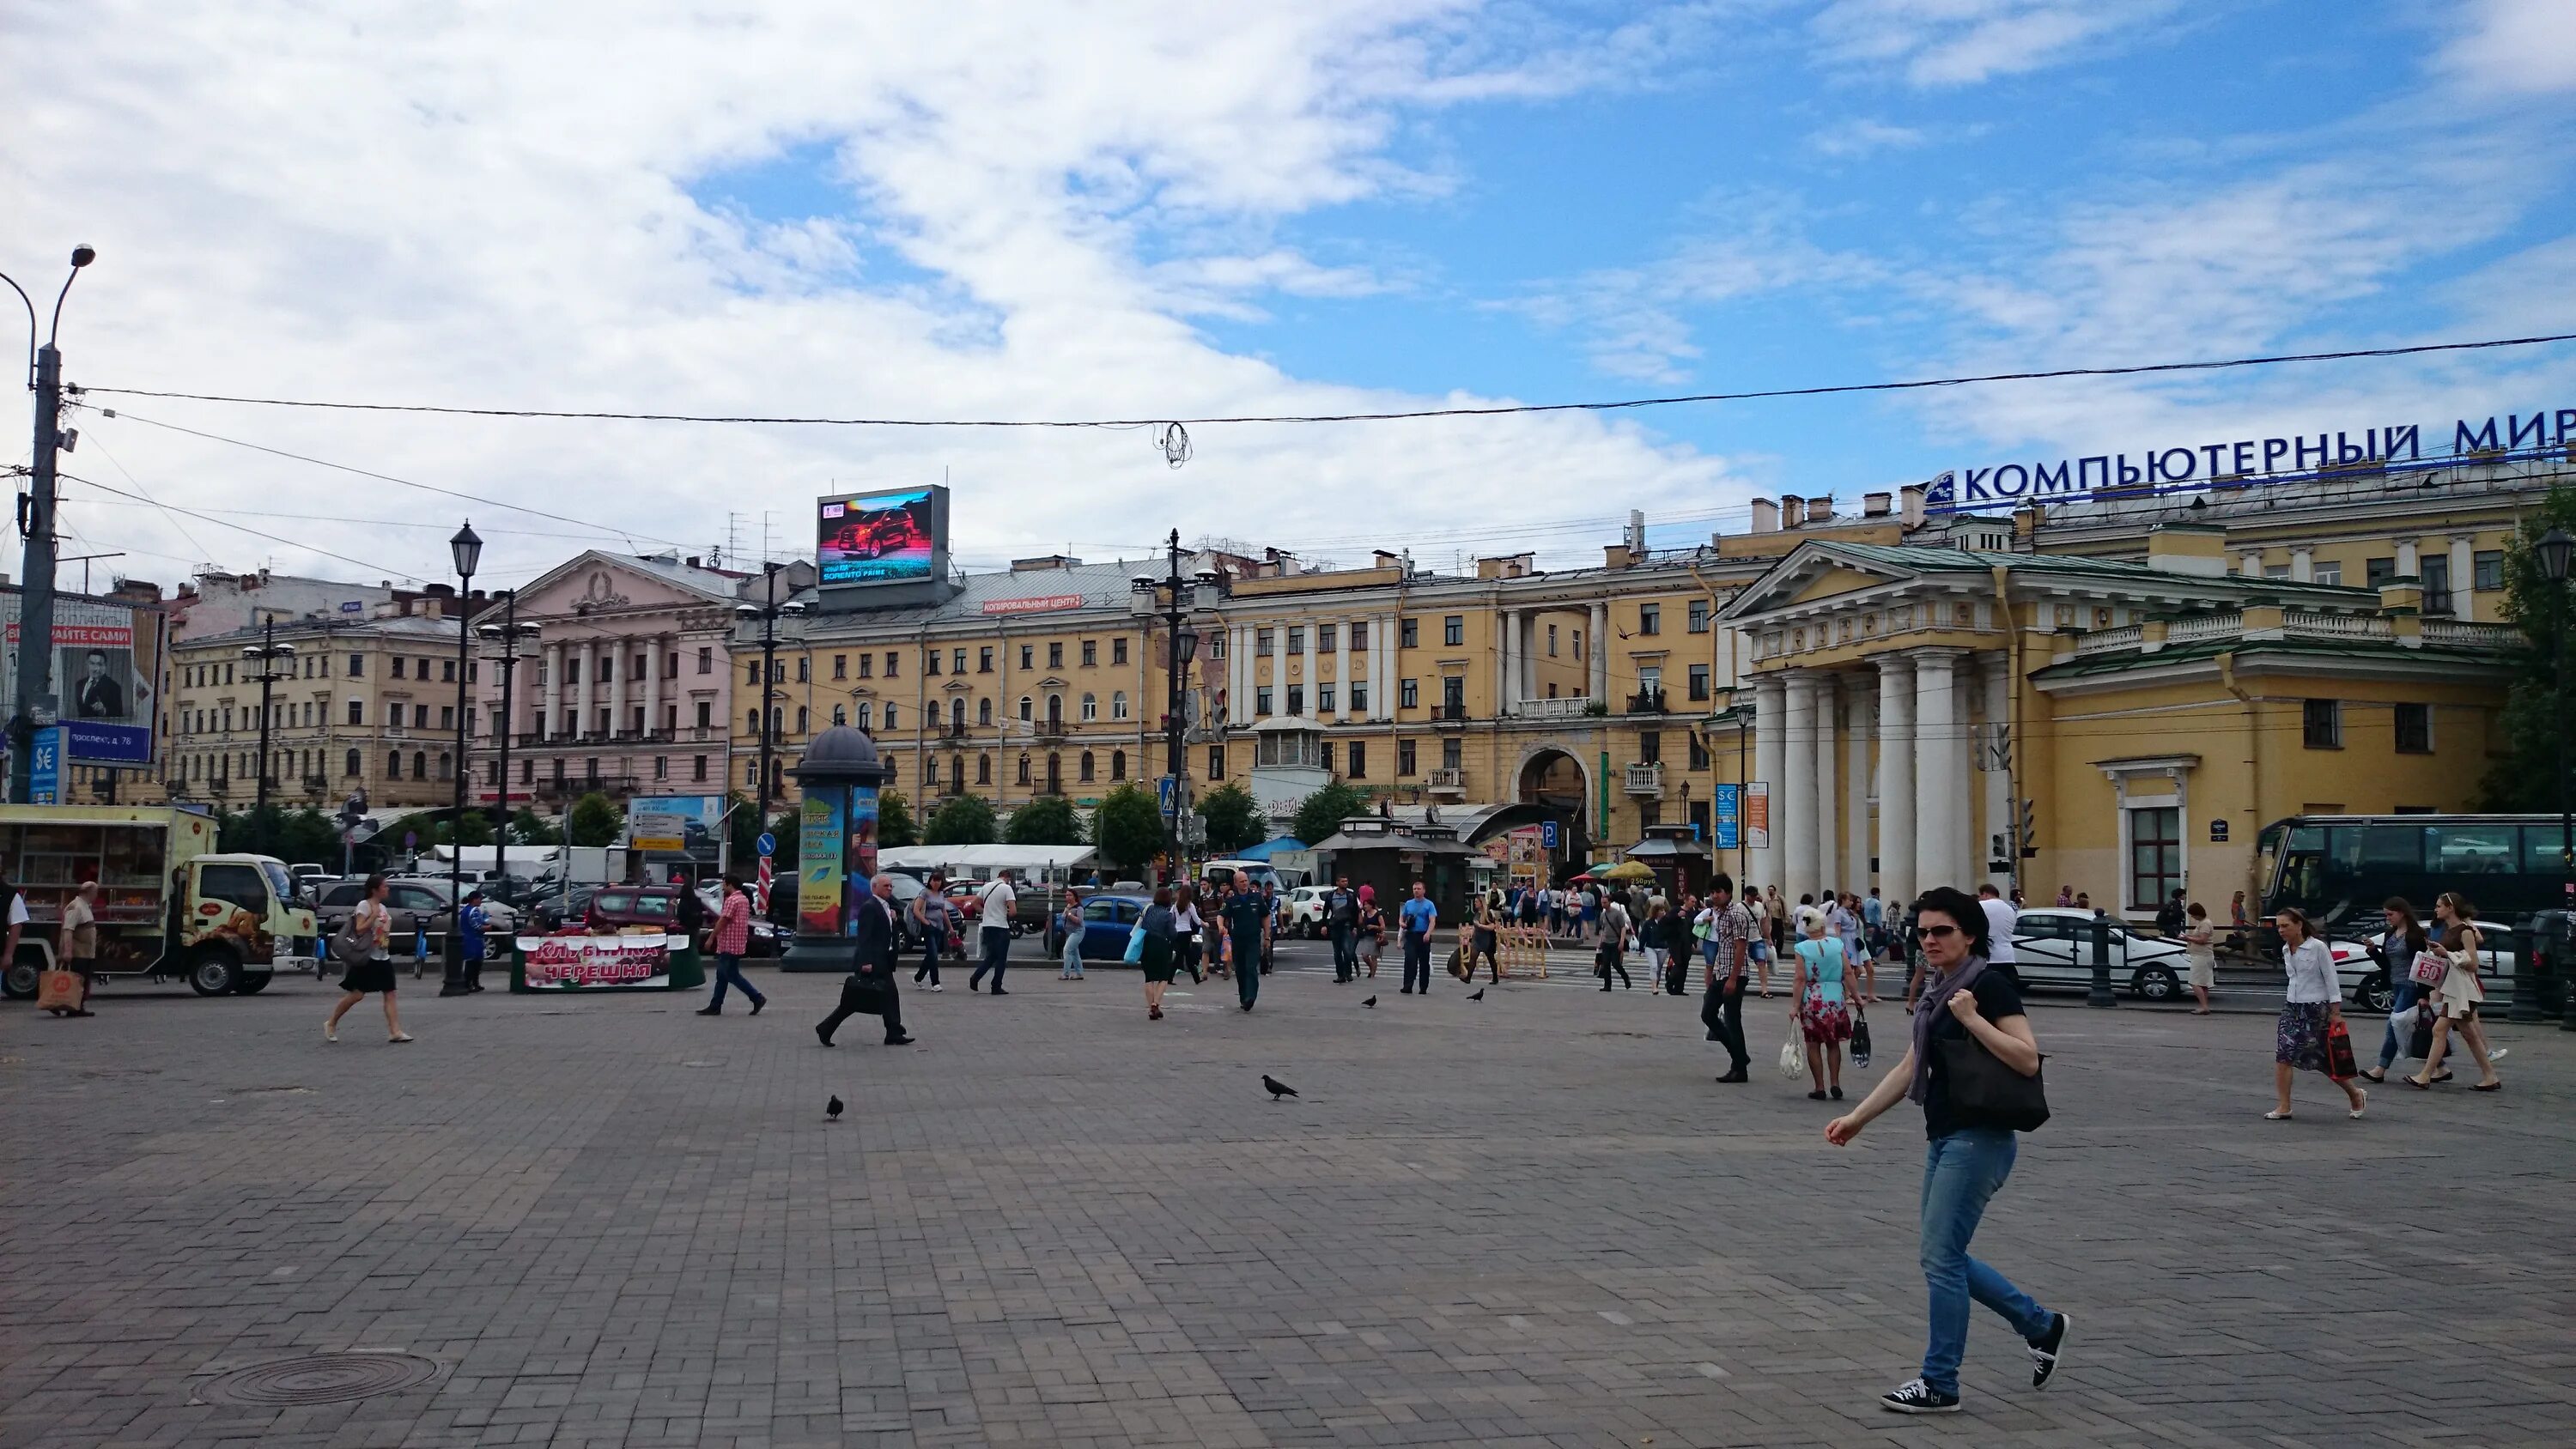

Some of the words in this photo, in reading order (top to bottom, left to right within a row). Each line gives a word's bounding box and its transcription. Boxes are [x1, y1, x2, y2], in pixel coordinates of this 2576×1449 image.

[1965, 424, 2419, 501] КОМПЬЮТЕРНЫЙ
[2454, 409, 2576, 454] МИР
[823, 571, 861, 580] SORENTO
[984, 598, 1048, 611] КОПИРОВАЛЬНЫЙ
[90, 629, 128, 641] САМИ
[1546, 826, 1553, 843] P
[544, 963, 652, 979] ЧЕРЕШНЯ
